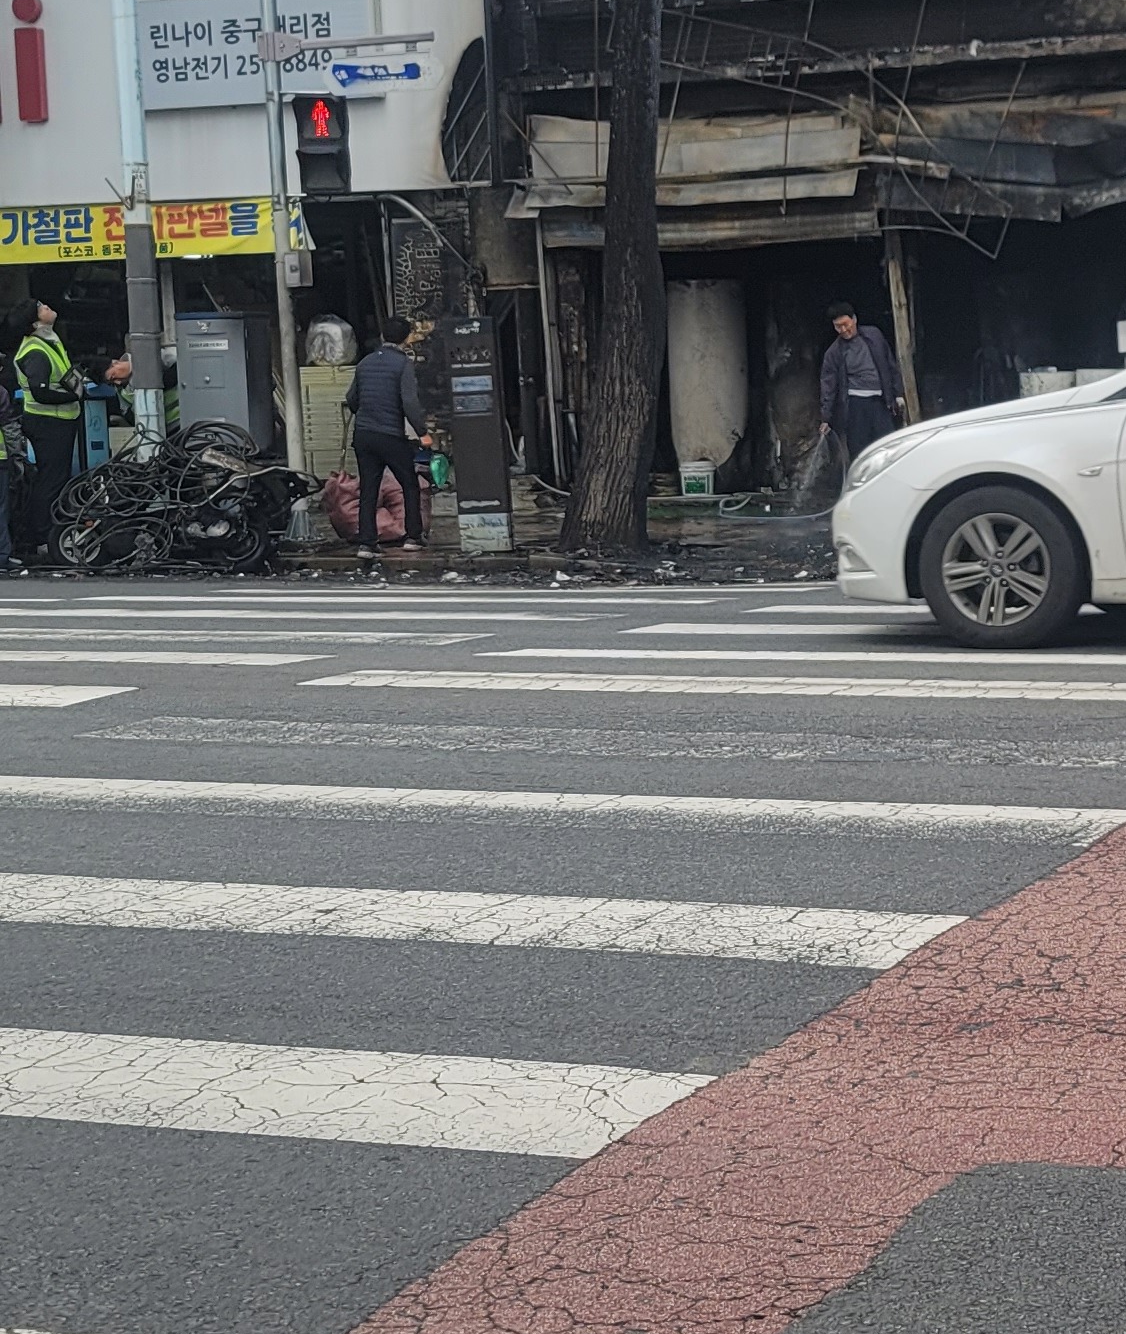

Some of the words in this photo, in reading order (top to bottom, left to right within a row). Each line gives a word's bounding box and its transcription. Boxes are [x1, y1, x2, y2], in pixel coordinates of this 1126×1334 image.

[149, 20, 214, 48] 린나이
[152, 52, 229, 84] 영남전기
[102, 202, 260, 242] 전판넬을
